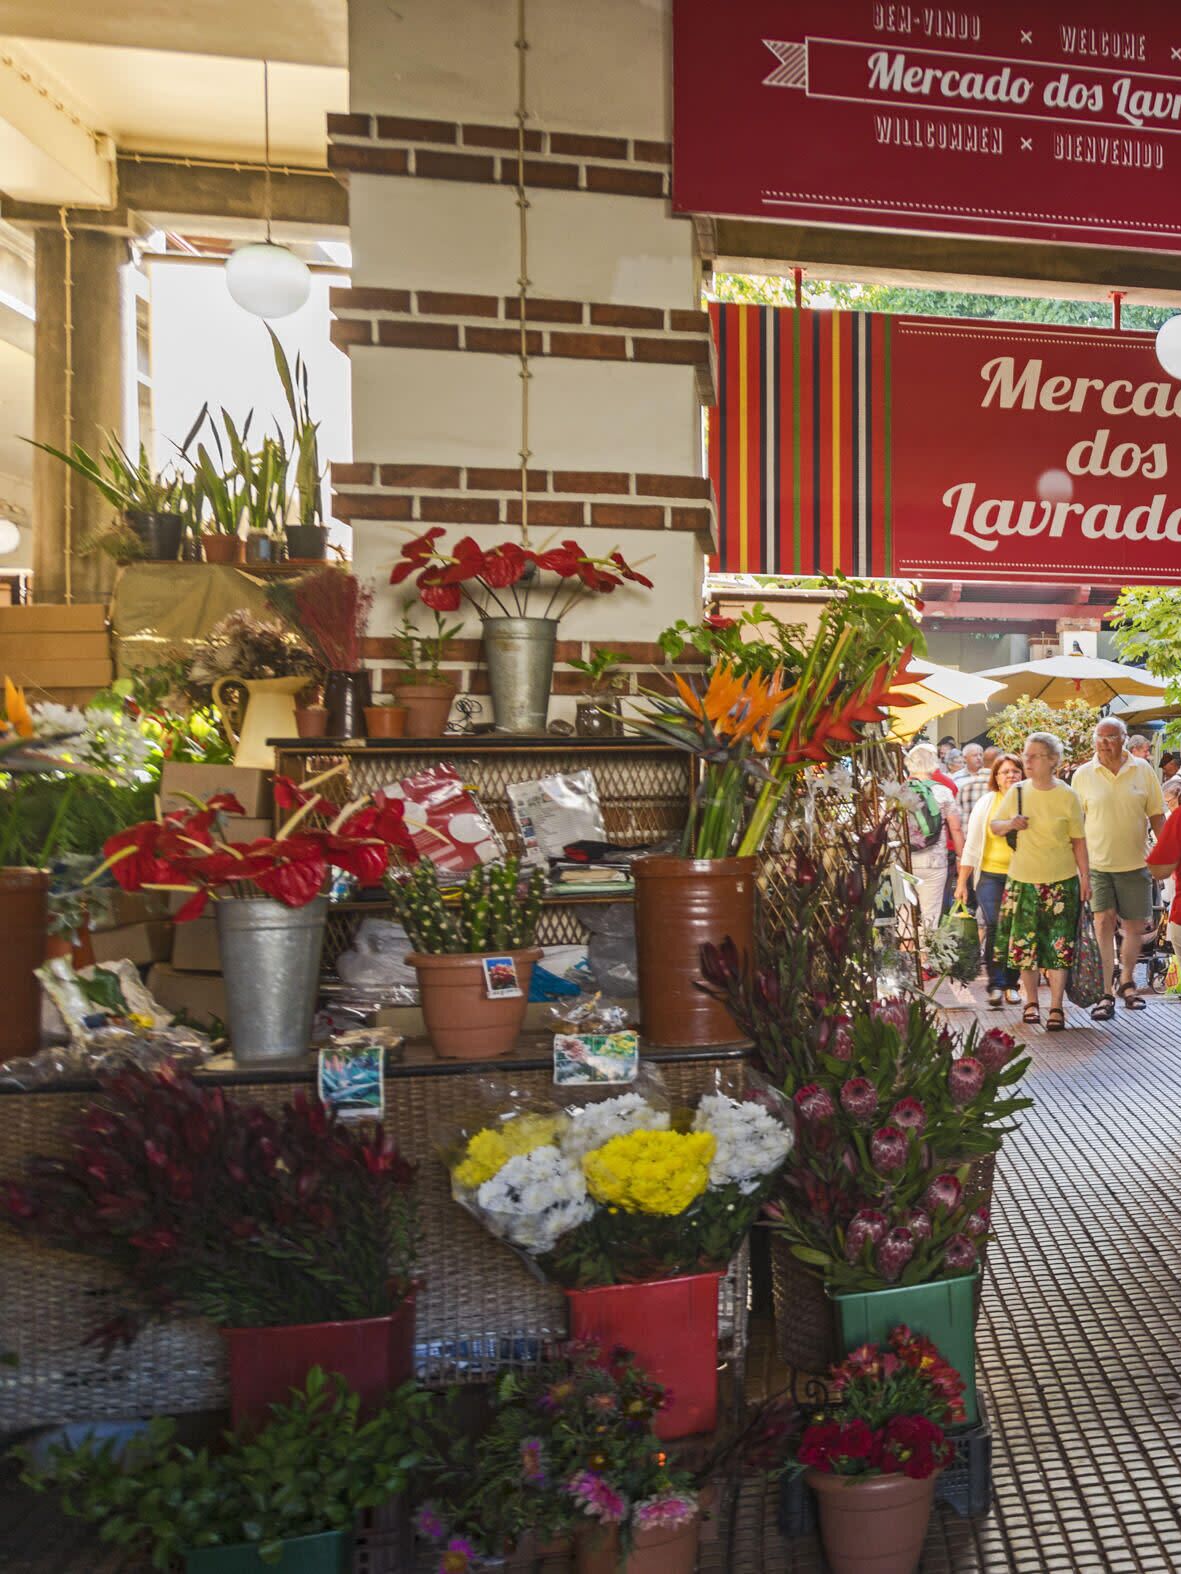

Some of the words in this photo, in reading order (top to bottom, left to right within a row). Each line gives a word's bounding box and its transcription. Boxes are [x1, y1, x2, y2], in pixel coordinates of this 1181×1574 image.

[873, 4, 980, 41] BEM-VINDO
[1059, 23, 1146, 61] WELCOME
[867, 51, 1034, 104] Mercado
[1042, 72, 1104, 112] dos
[873, 115, 1004, 155] WILLCOMMEN
[1053, 132, 1165, 170] BIENVENIDO
[1065, 428, 1169, 479] dos
